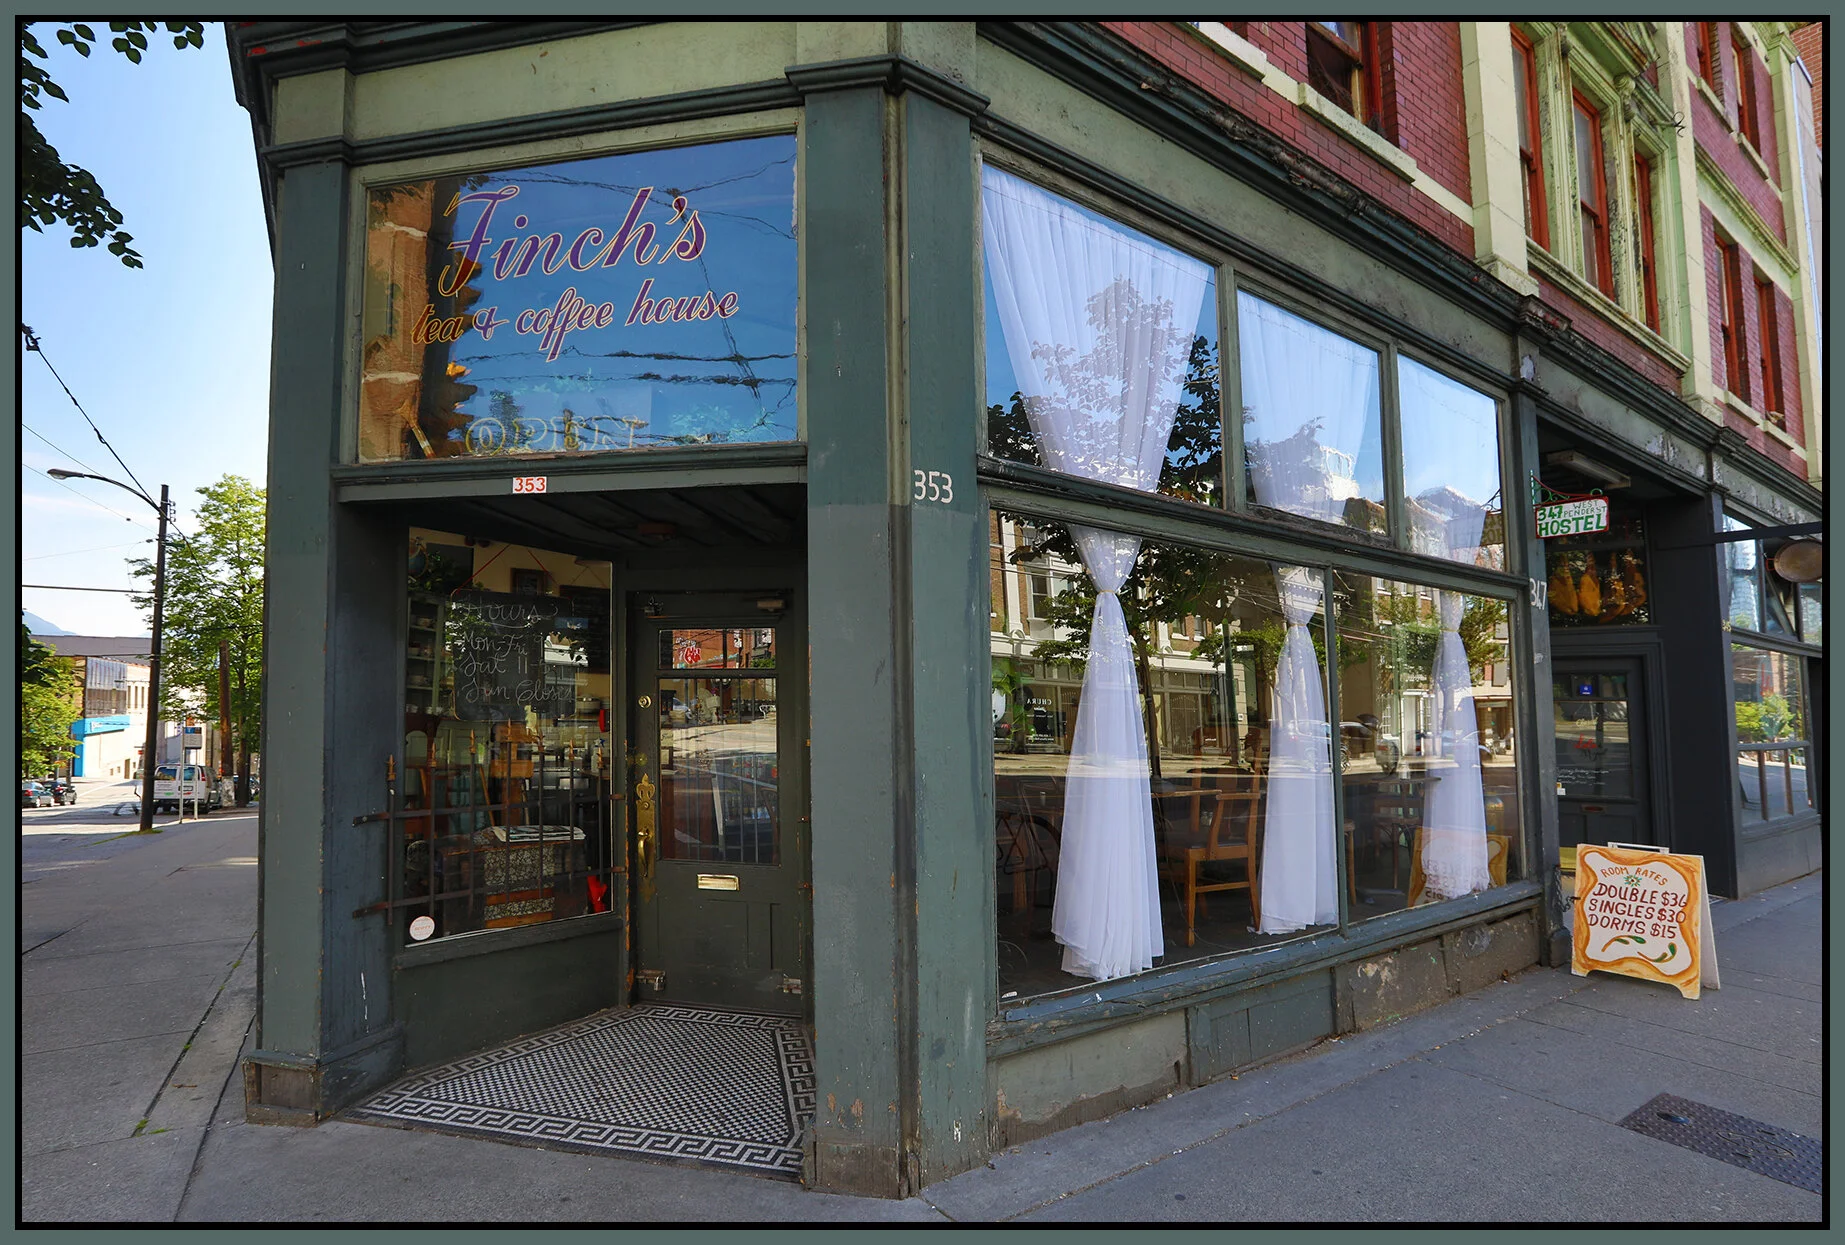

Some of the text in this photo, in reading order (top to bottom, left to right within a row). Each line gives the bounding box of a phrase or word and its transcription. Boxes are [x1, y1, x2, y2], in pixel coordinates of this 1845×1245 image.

[439, 185, 706, 297] Finch's
[410, 278, 739, 363] tea & coffee house
[465, 416, 642, 456] OPEN
[513, 477, 547, 494] 353
[914, 469, 953, 504] 353
[1537, 504, 1563, 522] 347
[1563, 505, 1608, 518] PENDER ST
[1573, 499, 1598, 510] WEST
[1538, 514, 1607, 536] HOSTEL
[1529, 577, 1548, 611] 347
[459, 651, 506, 678] Sat
[461, 678, 511, 704] Sun
[1601, 866, 1668, 886] ROOM RATES
[1593, 883, 1658, 904] DOUBLE
[1588, 899, 1687, 923] SINGLES $30
[1588, 914, 1677, 939] DORMS $15
